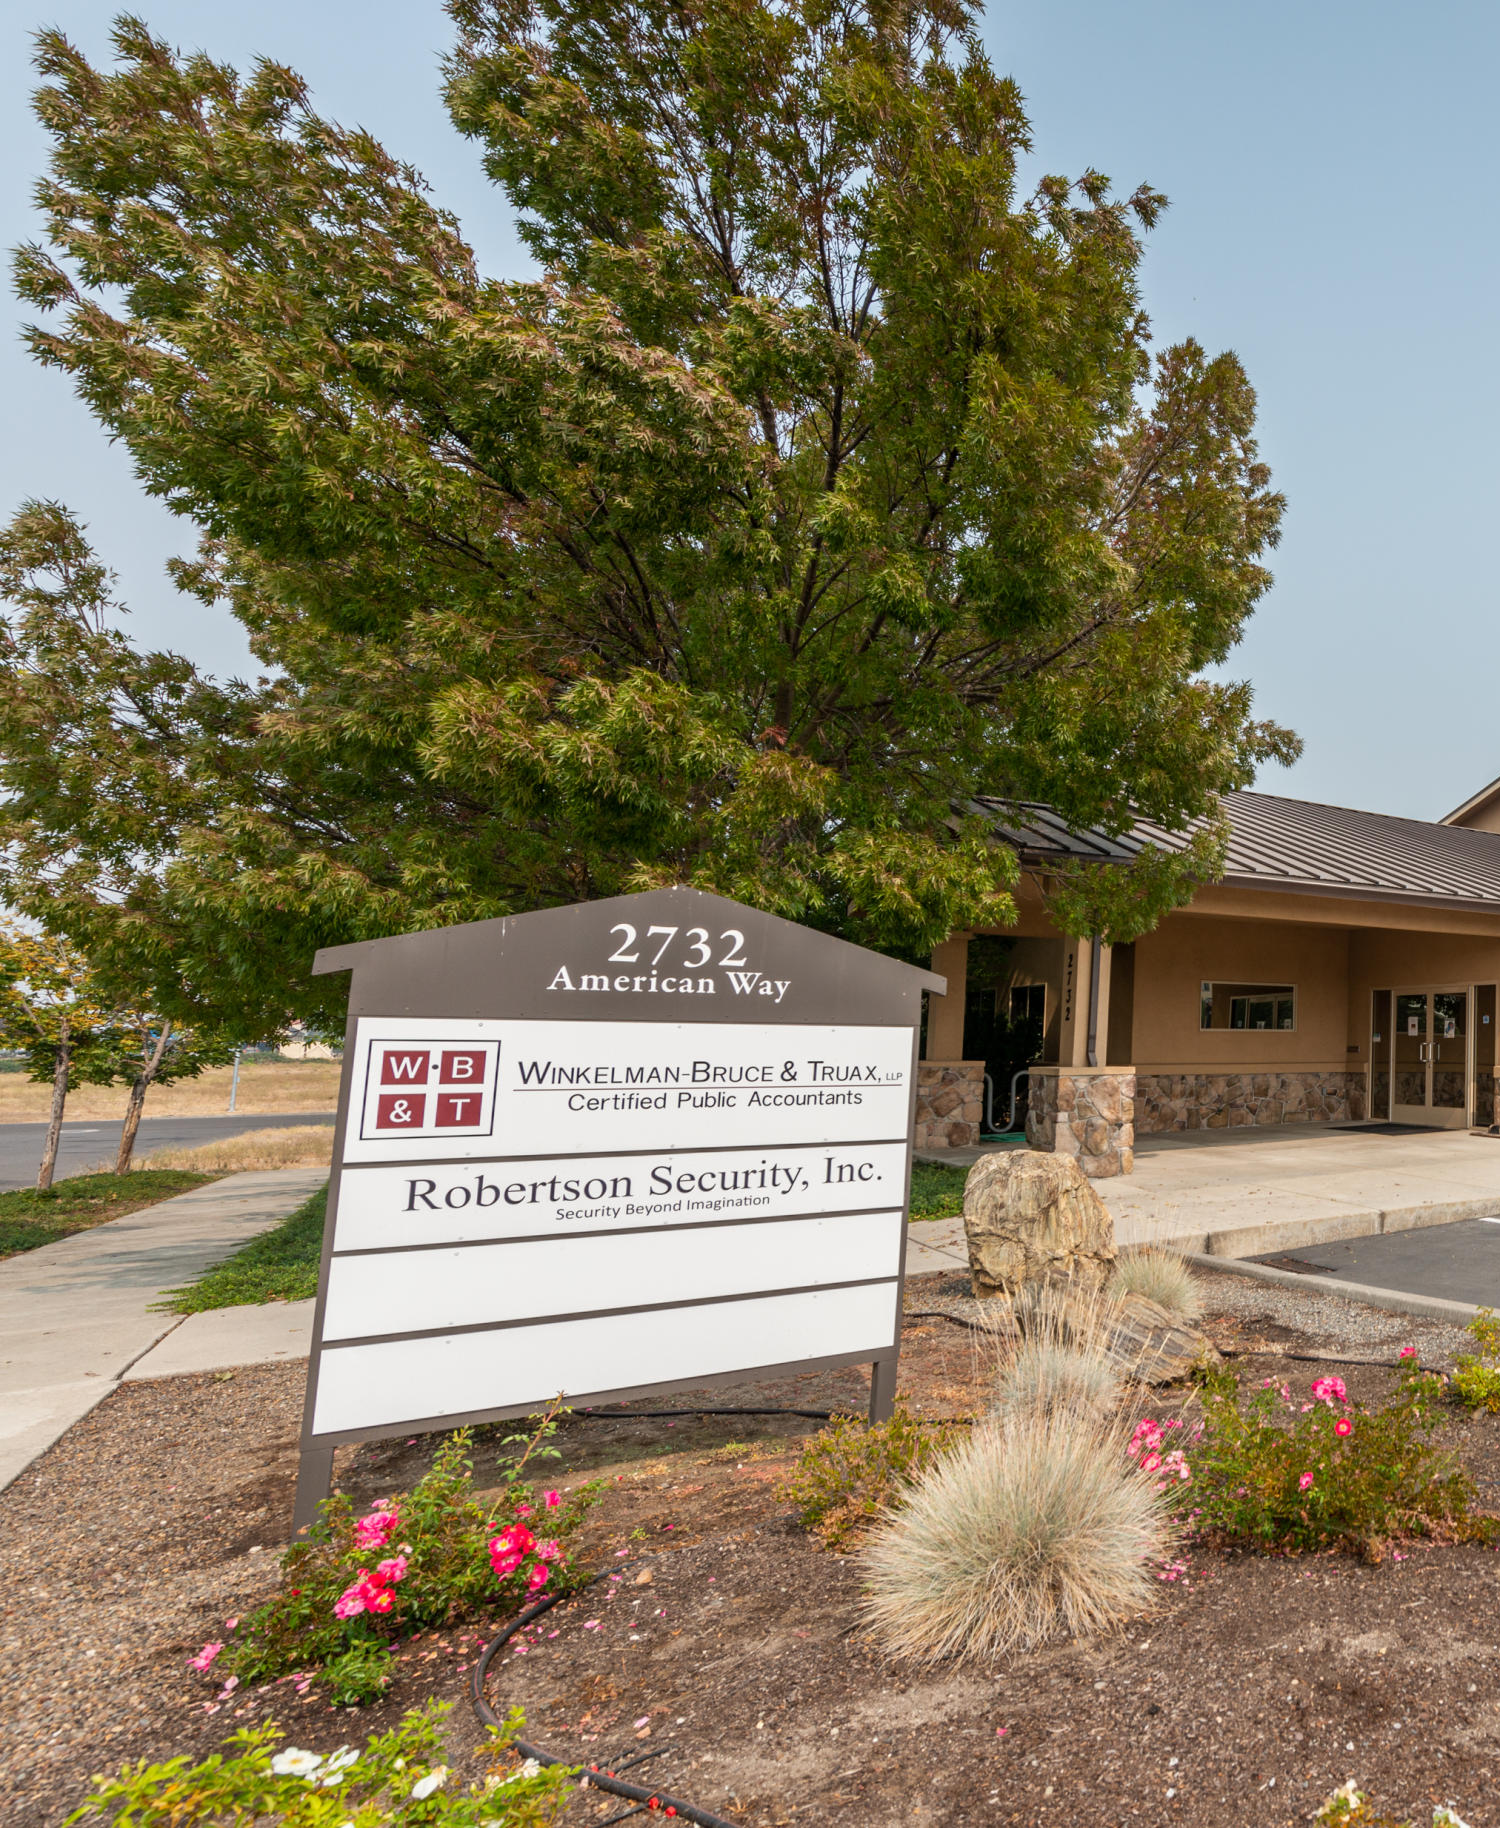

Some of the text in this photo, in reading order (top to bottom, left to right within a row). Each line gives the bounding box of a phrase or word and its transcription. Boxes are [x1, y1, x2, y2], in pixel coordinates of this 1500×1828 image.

[608, 923, 748, 968] 2732
[546, 965, 792, 1003] American Way
[780, 1060, 798, 1082] &
[808, 1060, 882, 1083] TRUAX,
[885, 1071, 903, 1081] LLP
[389, 1098, 471, 1123] & T
[568, 1090, 863, 1111] Certified Public Accountants
[401, 1157, 883, 1212] Robertson Security, Inc.
[555, 1195, 770, 1221] Security Beyond Imagination
